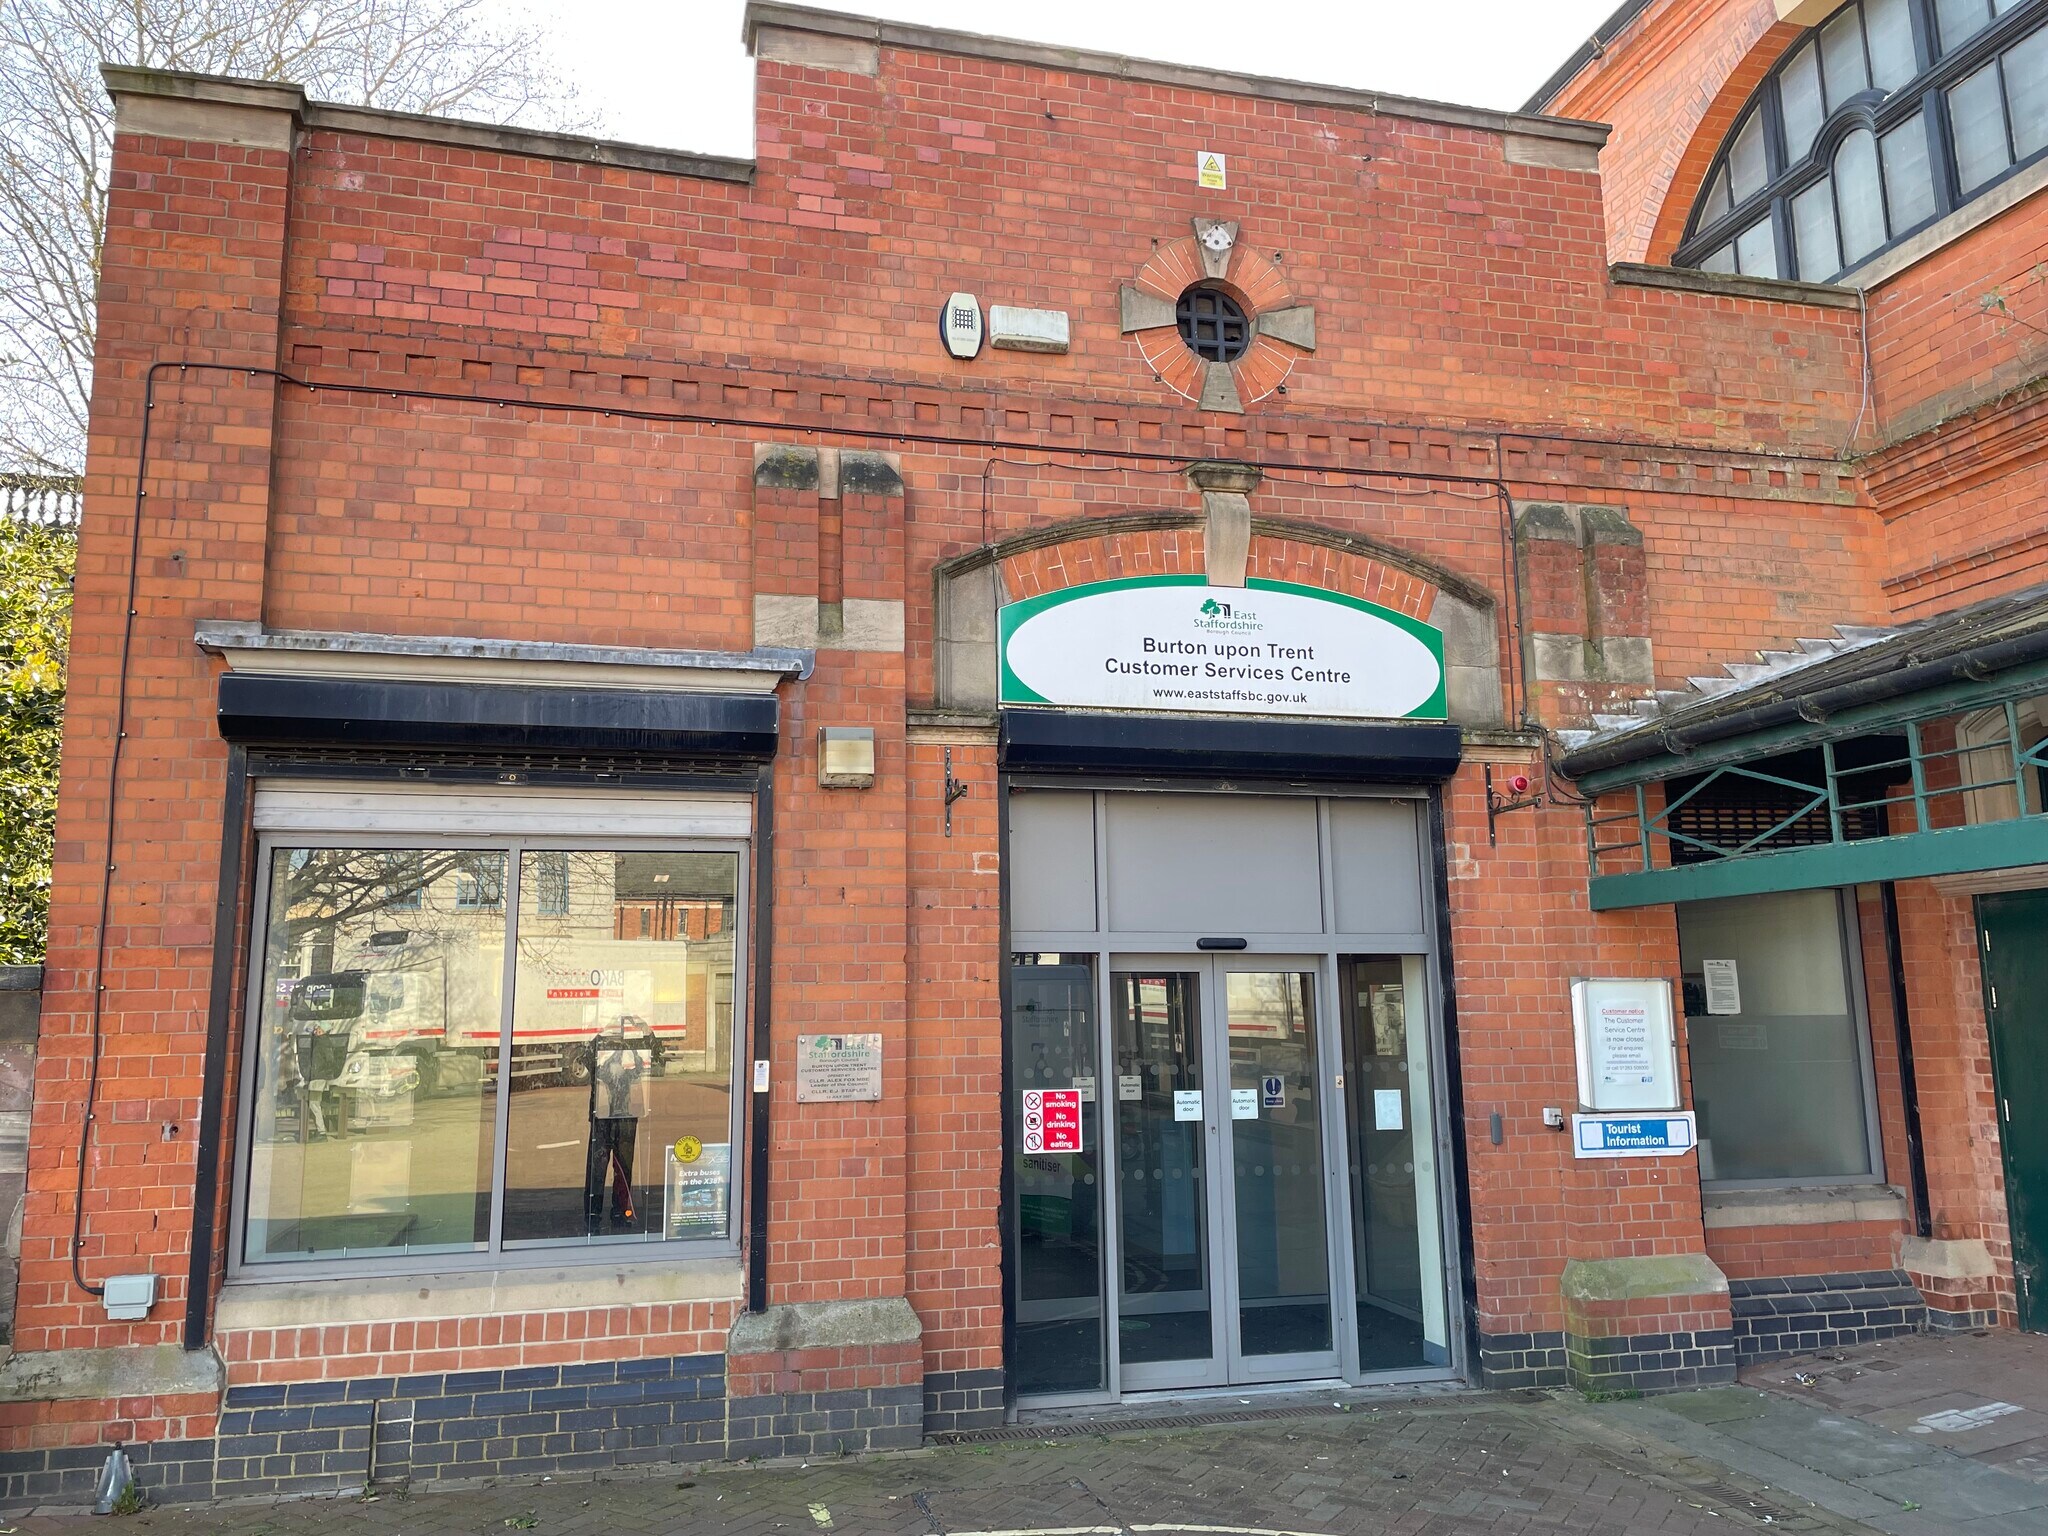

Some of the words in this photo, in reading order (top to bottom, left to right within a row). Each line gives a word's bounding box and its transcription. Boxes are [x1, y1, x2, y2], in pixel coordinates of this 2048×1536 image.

[1233, 610, 1257, 621] East
[1193, 618, 1264, 631] Staffordshire
[1143, 637, 1207, 655] Burton
[1214, 643, 1261, 660] upon
[1266, 643, 1315, 660] Trent
[1105, 657, 1199, 677] Customer
[1204, 661, 1285, 681] Services
[1290, 666, 1351, 684] Centre
[1152, 688, 1308, 705] www.eaststaffsbc.gov.uk
[1055, 1092, 1067, 1100] No
[1045, 1101, 1077, 1109] smoking
[1055, 1112, 1067, 1120] No
[1046, 1121, 1077, 1129] drinking
[1605, 1123, 1642, 1134] Tourist
[1055, 1132, 1068, 1140] No
[1606, 1135, 1665, 1147] Information
[1050, 1141, 1073, 1149] eating
[1023, 1157, 1061, 1173] sanitiser
